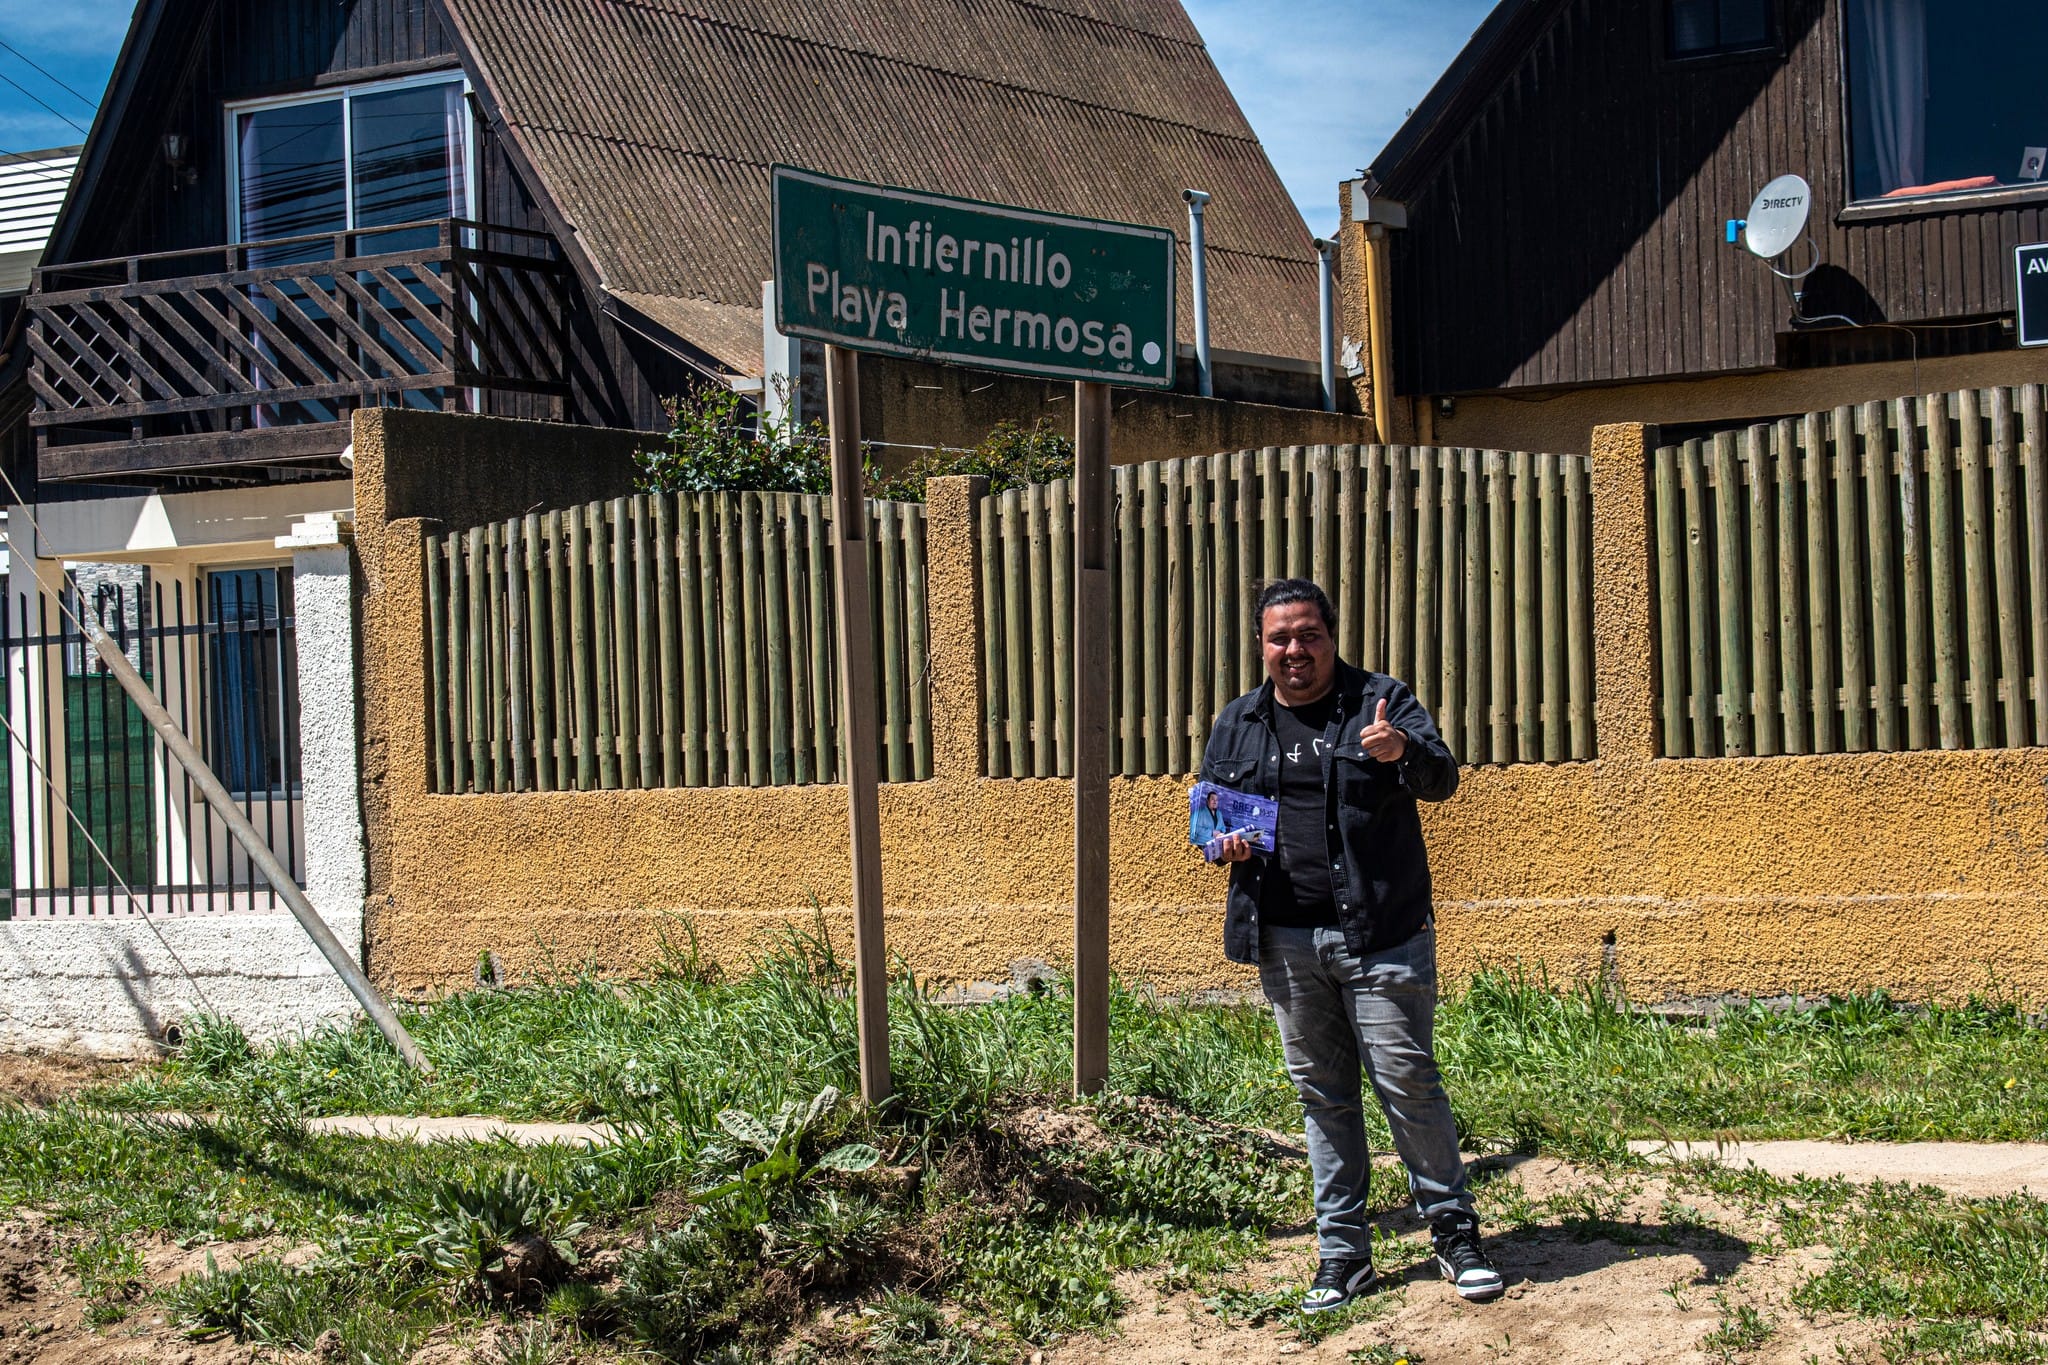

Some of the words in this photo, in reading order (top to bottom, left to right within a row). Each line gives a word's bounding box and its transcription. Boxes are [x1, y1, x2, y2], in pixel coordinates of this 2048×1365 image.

[1761, 196, 1804, 210] DIRECTV
[866, 211, 1072, 289] Infiernillo
[806, 263, 908, 338] Playa
[939, 287, 1134, 359] Hermosa
